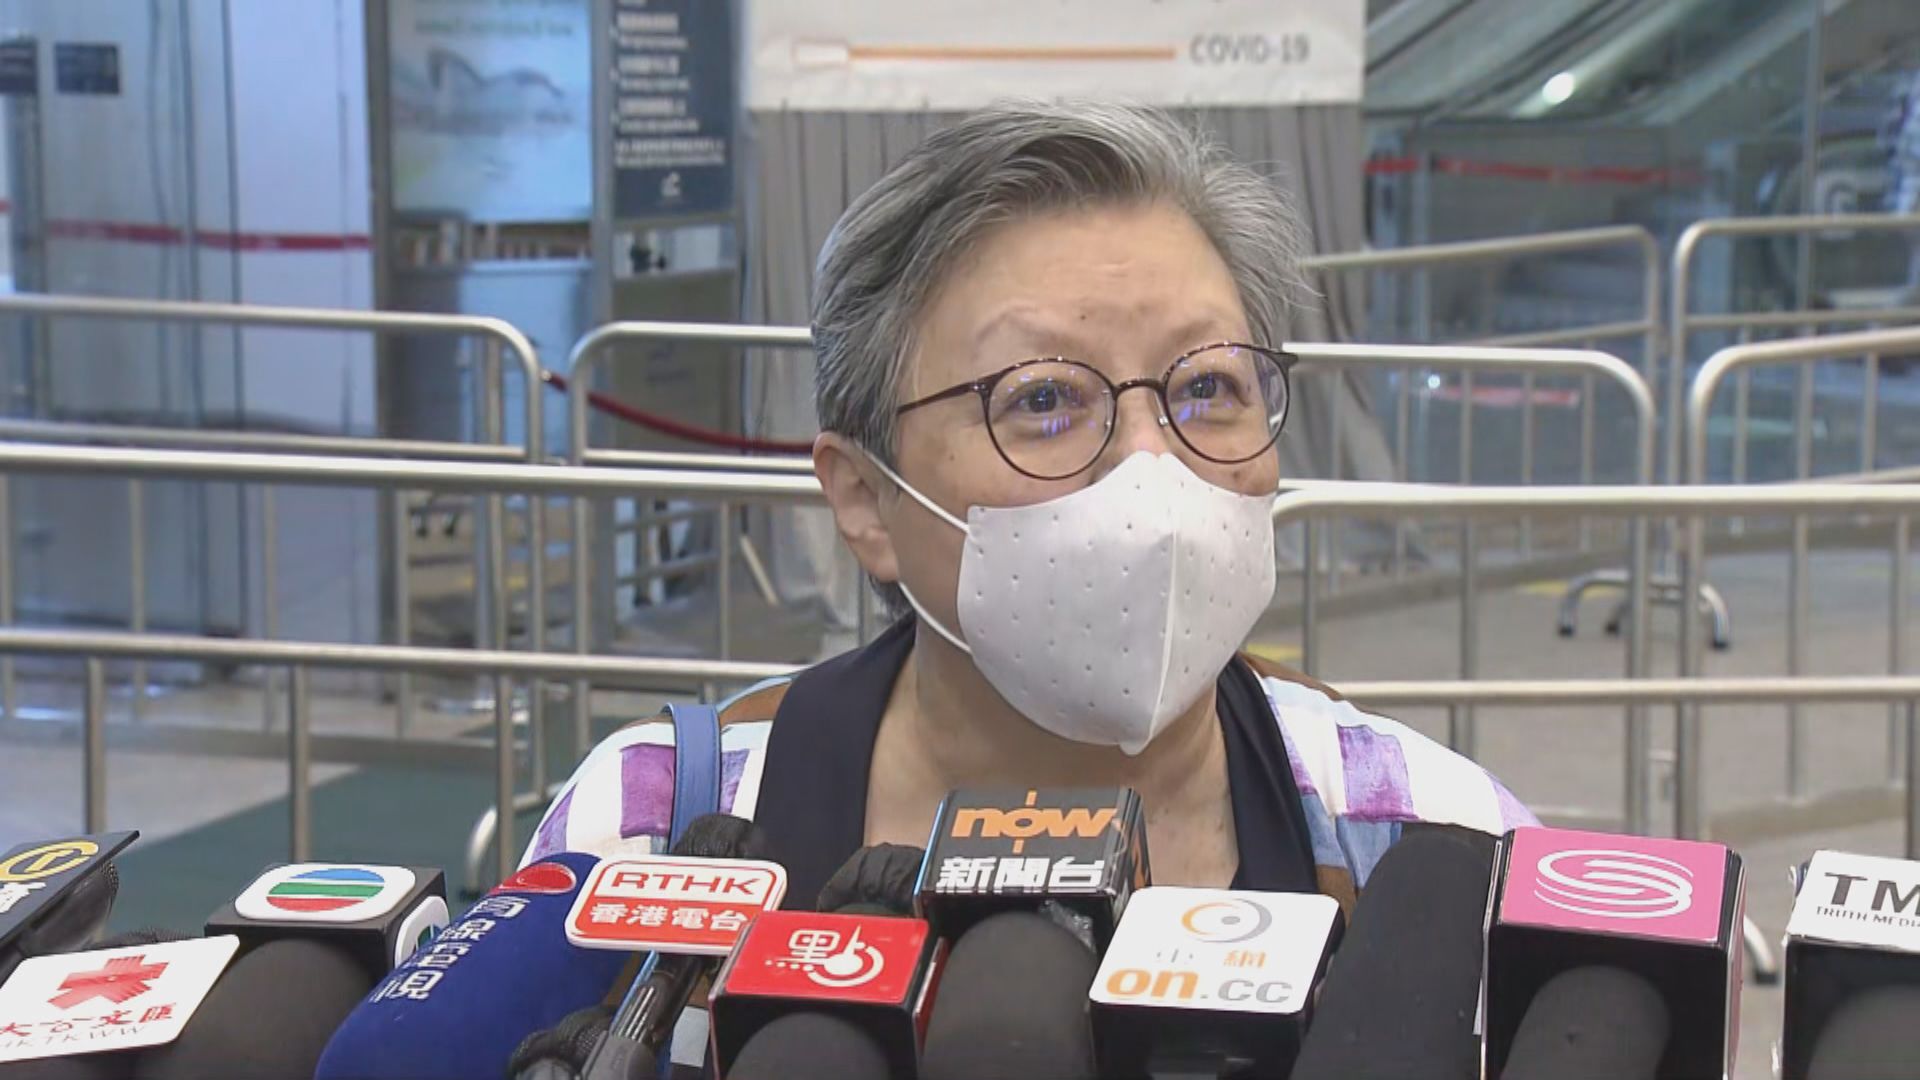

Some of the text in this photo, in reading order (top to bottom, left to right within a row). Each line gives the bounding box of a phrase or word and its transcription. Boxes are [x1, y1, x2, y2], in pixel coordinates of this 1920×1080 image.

[1189, 33, 1311, 65] COVID-19
[611, 871, 761, 895] RTHK
[935, 855, 1105, 894] 新聞台
[590, 902, 748, 932] 香港電台
[1873, 914, 1920, 928] MEDI
[1106, 968, 1293, 1004] on.cc
